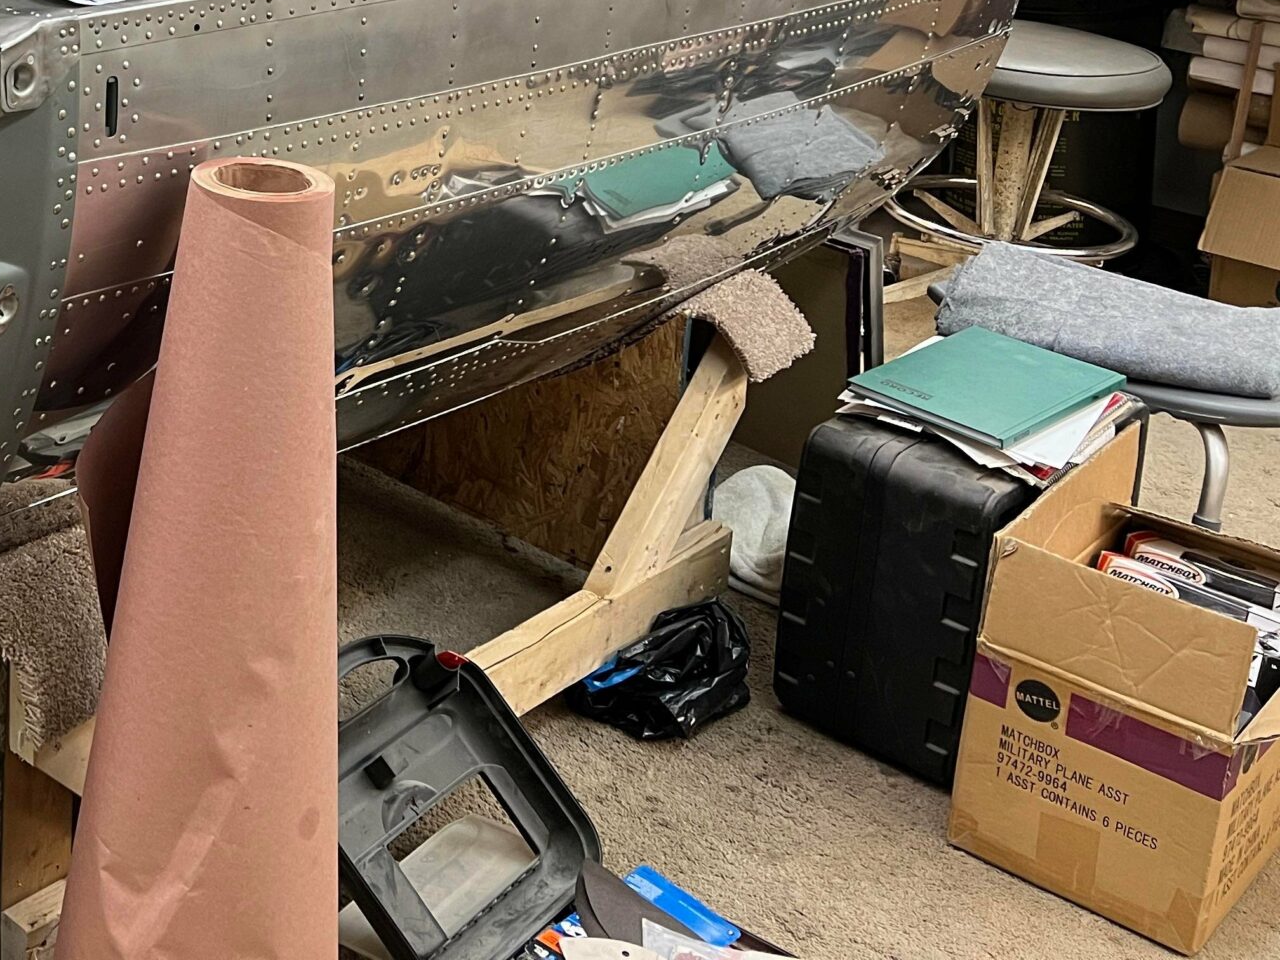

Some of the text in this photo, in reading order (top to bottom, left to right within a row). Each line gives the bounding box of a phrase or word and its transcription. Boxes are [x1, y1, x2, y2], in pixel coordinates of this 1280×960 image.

[1135, 554, 1201, 581] MATCHBOX
[1016, 690, 1060, 711] MATTEL
[1001, 724, 1061, 760] MATCHBOX
[997, 751, 1068, 794] 97472-9964
[999, 737, 1130, 806] MILITARY PLANE ASST
[1006, 772, 1037, 794] ASST
[1041, 788, 1098, 823] CONTAINS
[1102, 815, 1111, 828] 6
[1115, 820, 1159, 851] PIECES
